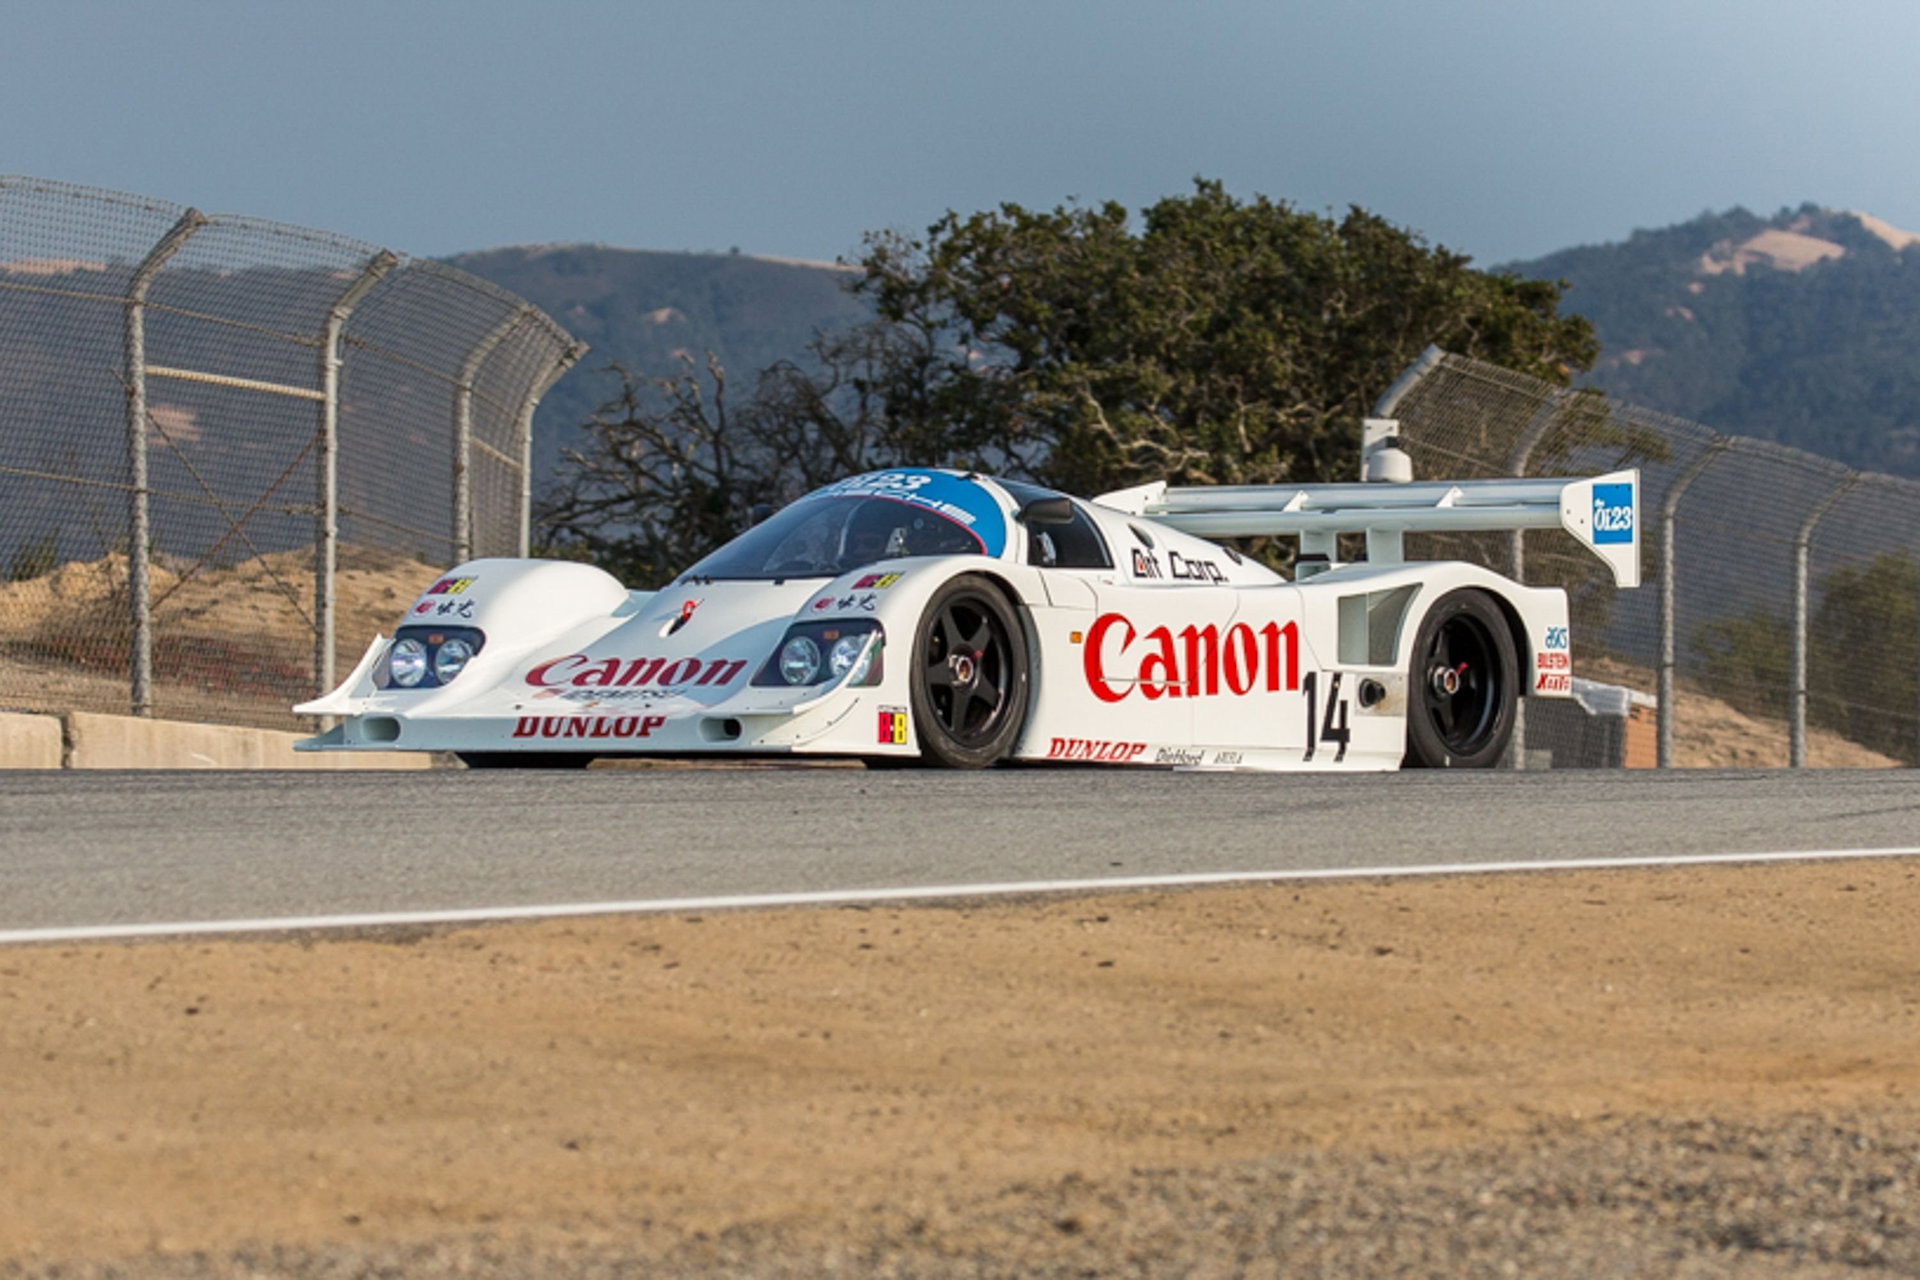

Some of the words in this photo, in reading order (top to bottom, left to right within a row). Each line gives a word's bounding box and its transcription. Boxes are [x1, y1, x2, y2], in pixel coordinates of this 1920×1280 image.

[525, 654, 748, 687] Canon
[1083, 611, 1299, 703] Canon
[512, 714, 668, 739] DUNLOP
[1302, 671, 1350, 763] 14
[1047, 736, 1147, 762] DUNLOP
